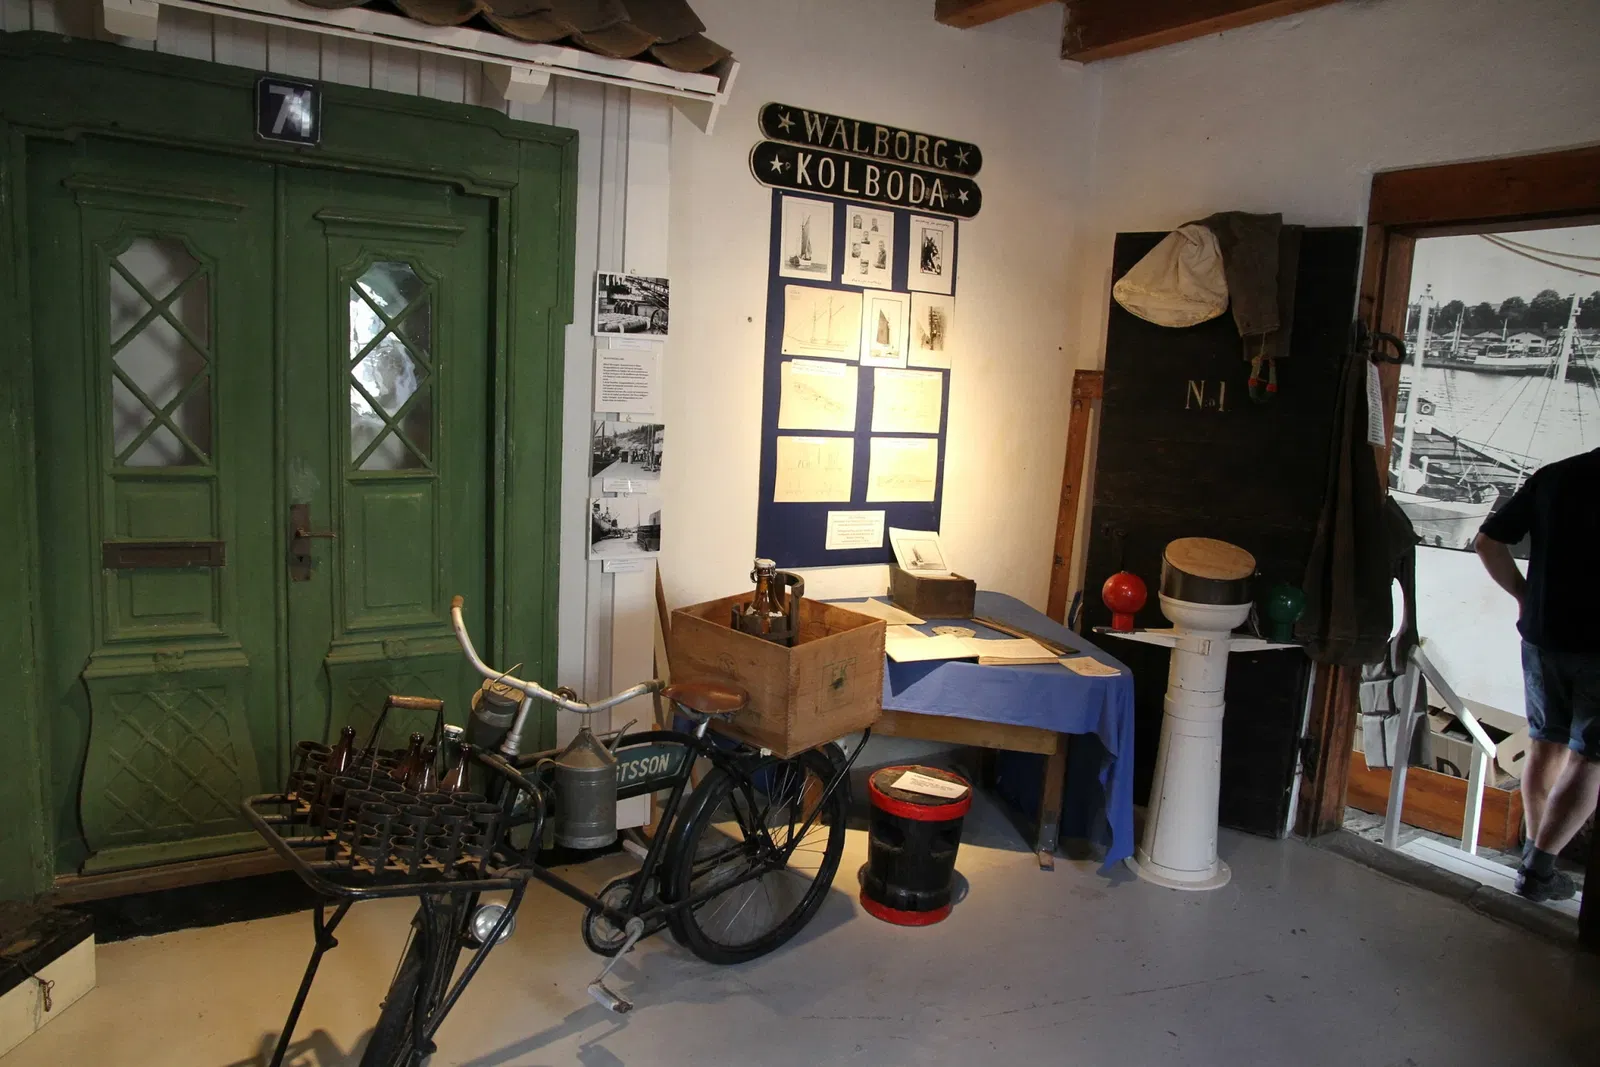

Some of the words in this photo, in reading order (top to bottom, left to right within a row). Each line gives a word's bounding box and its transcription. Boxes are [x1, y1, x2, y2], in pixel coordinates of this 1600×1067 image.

[269, 84, 311, 138] 71
[802, 110, 949, 169] WALBORG
[796, 152, 945, 208] KOLBODA
